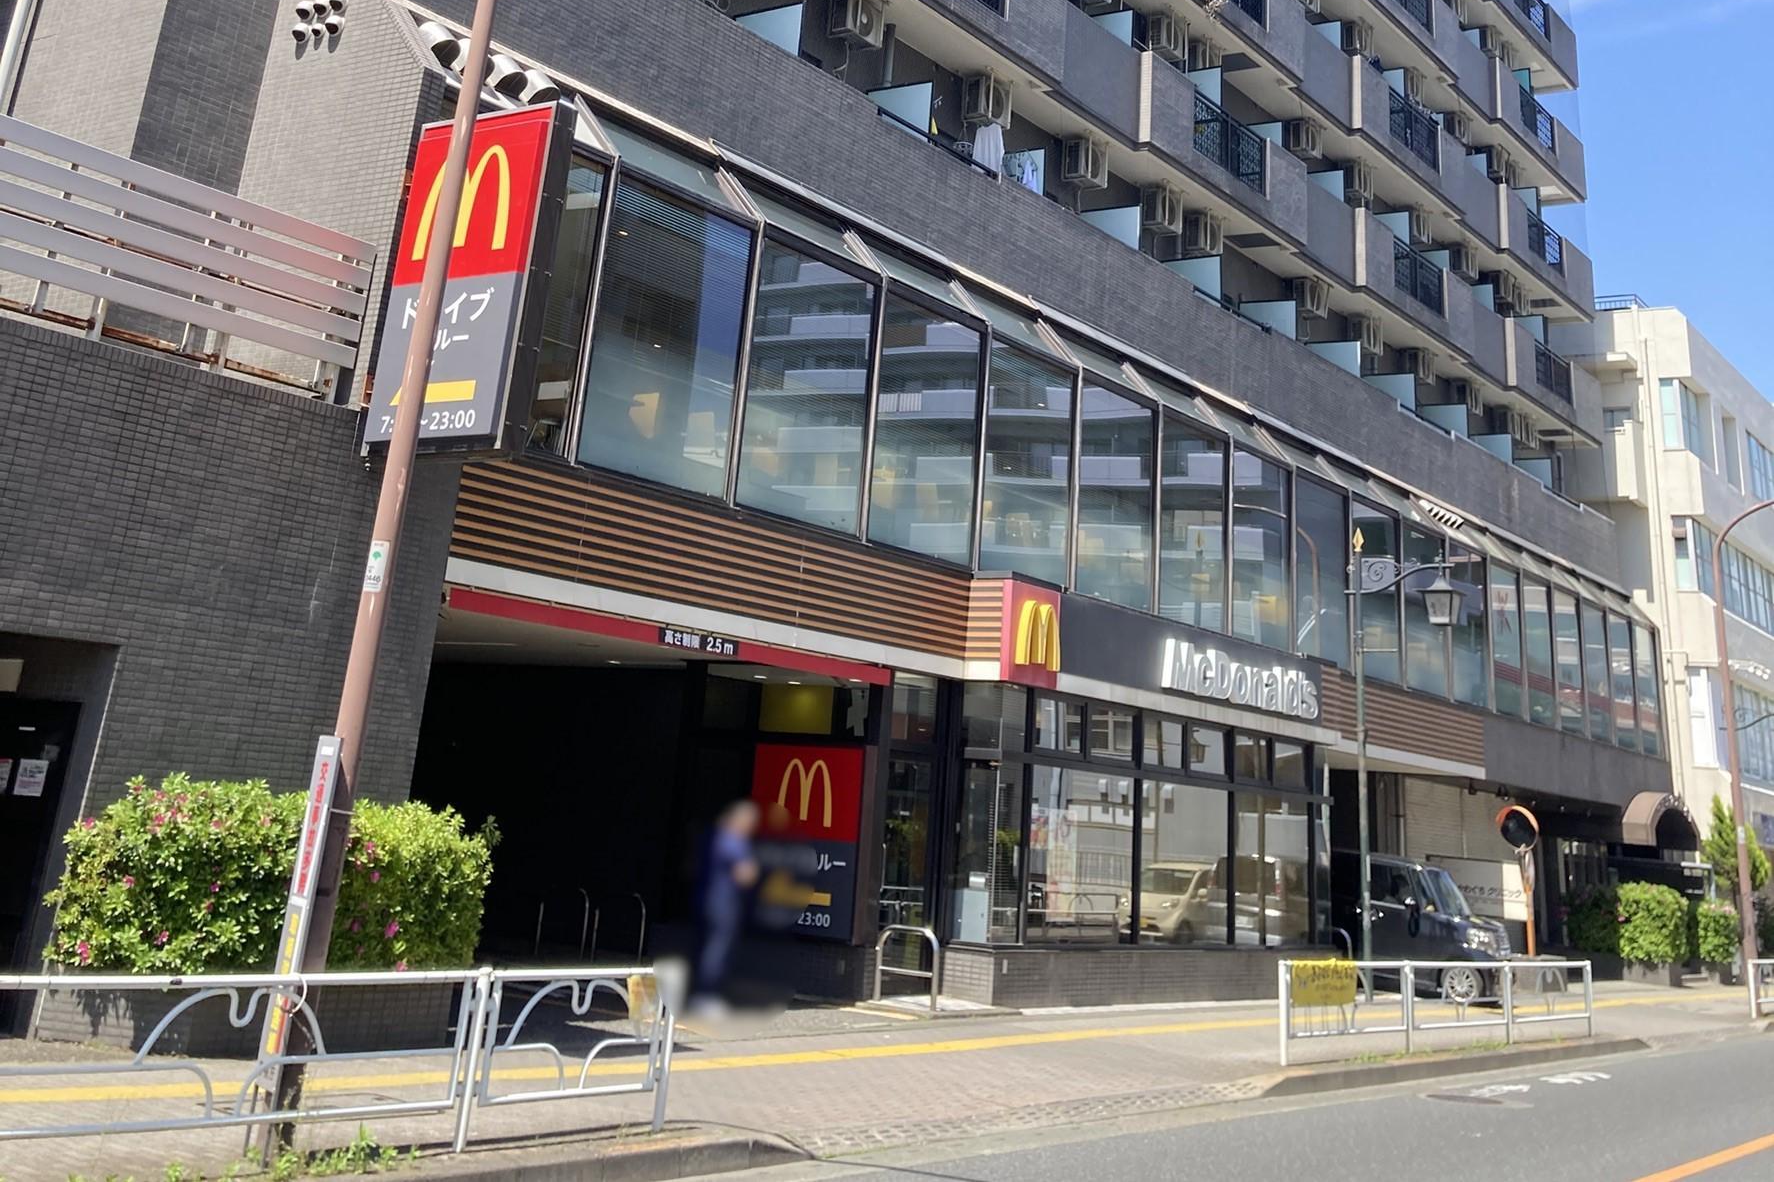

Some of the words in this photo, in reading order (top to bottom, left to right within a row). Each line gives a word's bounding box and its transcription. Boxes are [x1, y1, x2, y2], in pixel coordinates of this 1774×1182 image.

[402, 287, 495, 329] ドイブ
[428, 328, 470, 351] ルー
[664, 629, 700, 649] 高さ制限
[1161, 638, 1319, 719] McDonald's
